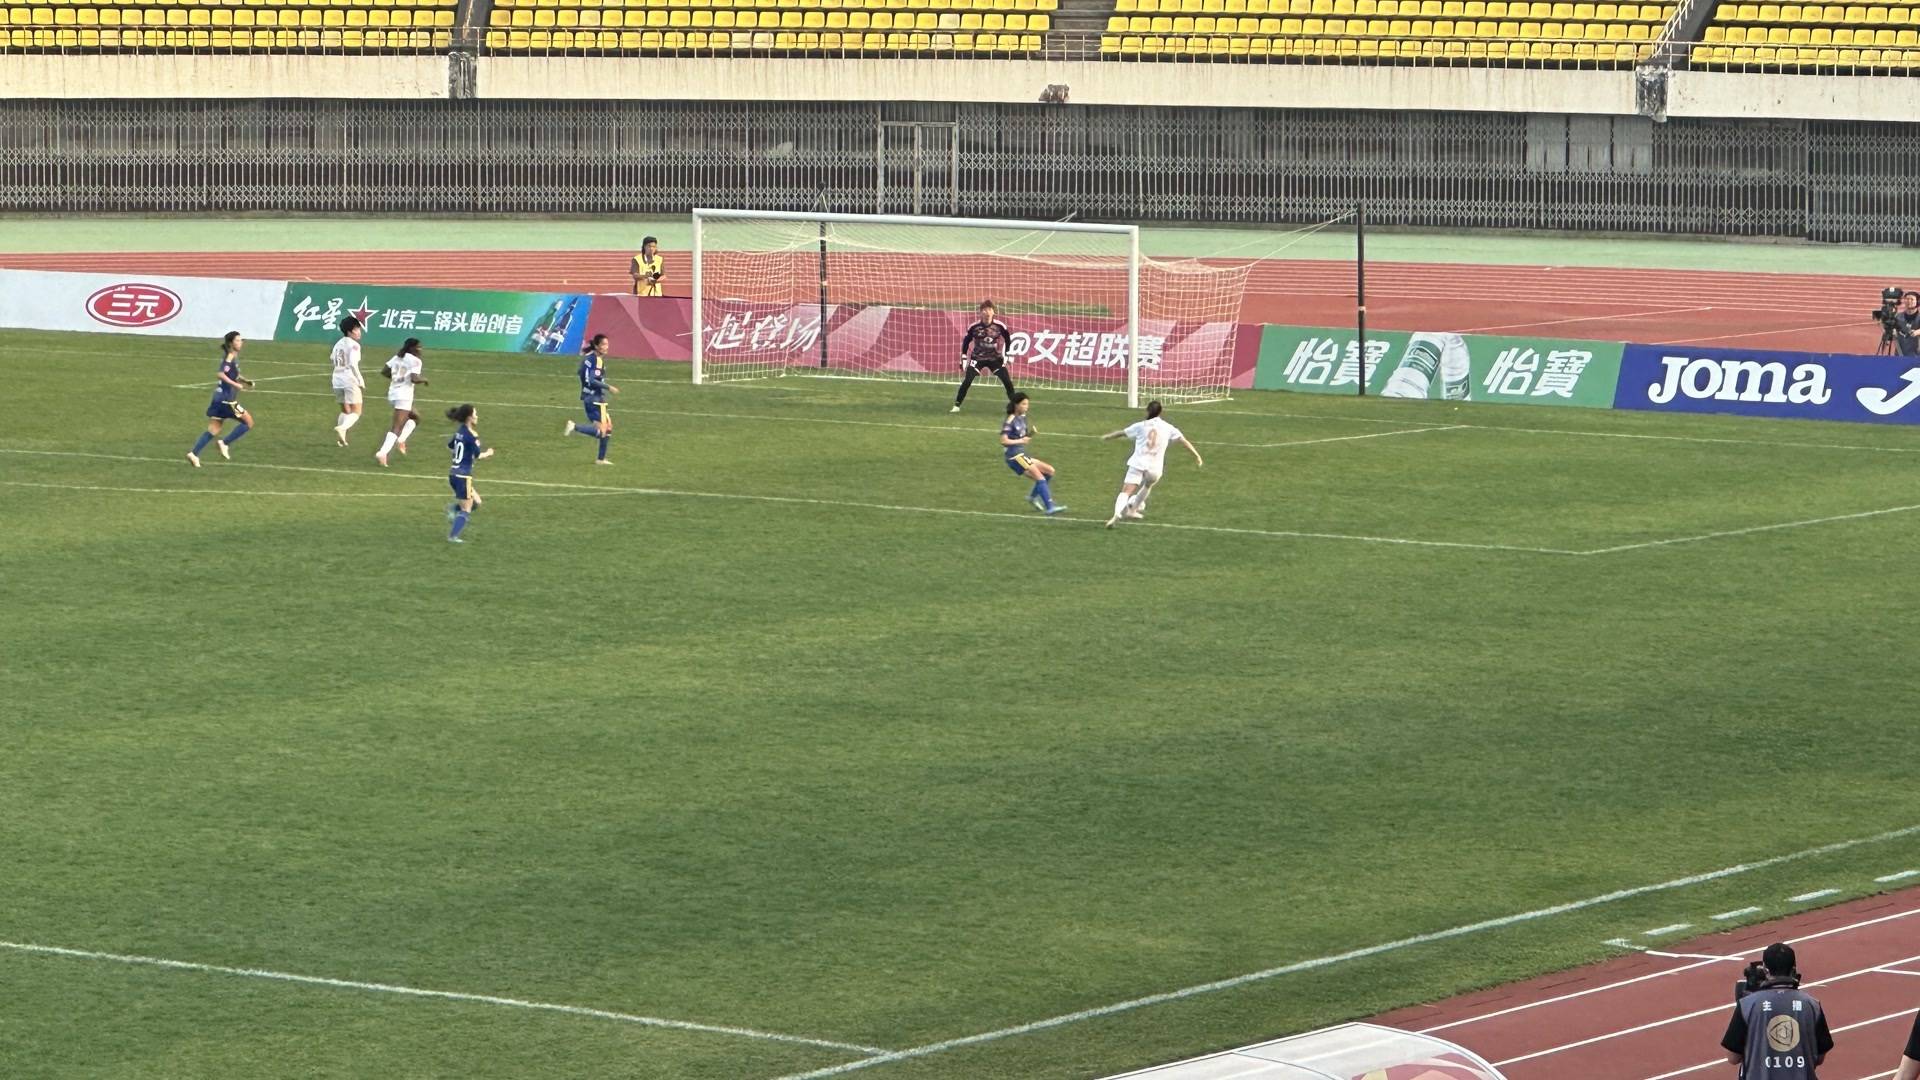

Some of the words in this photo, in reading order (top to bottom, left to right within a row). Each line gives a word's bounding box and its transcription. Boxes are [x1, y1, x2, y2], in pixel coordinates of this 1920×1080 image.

[107, 293, 160, 318] 三元
[293, 296, 343, 332] 红星
[379, 308, 524, 335] 北京二锅头始创者
[1482, 347, 1593, 398] 怡寶
